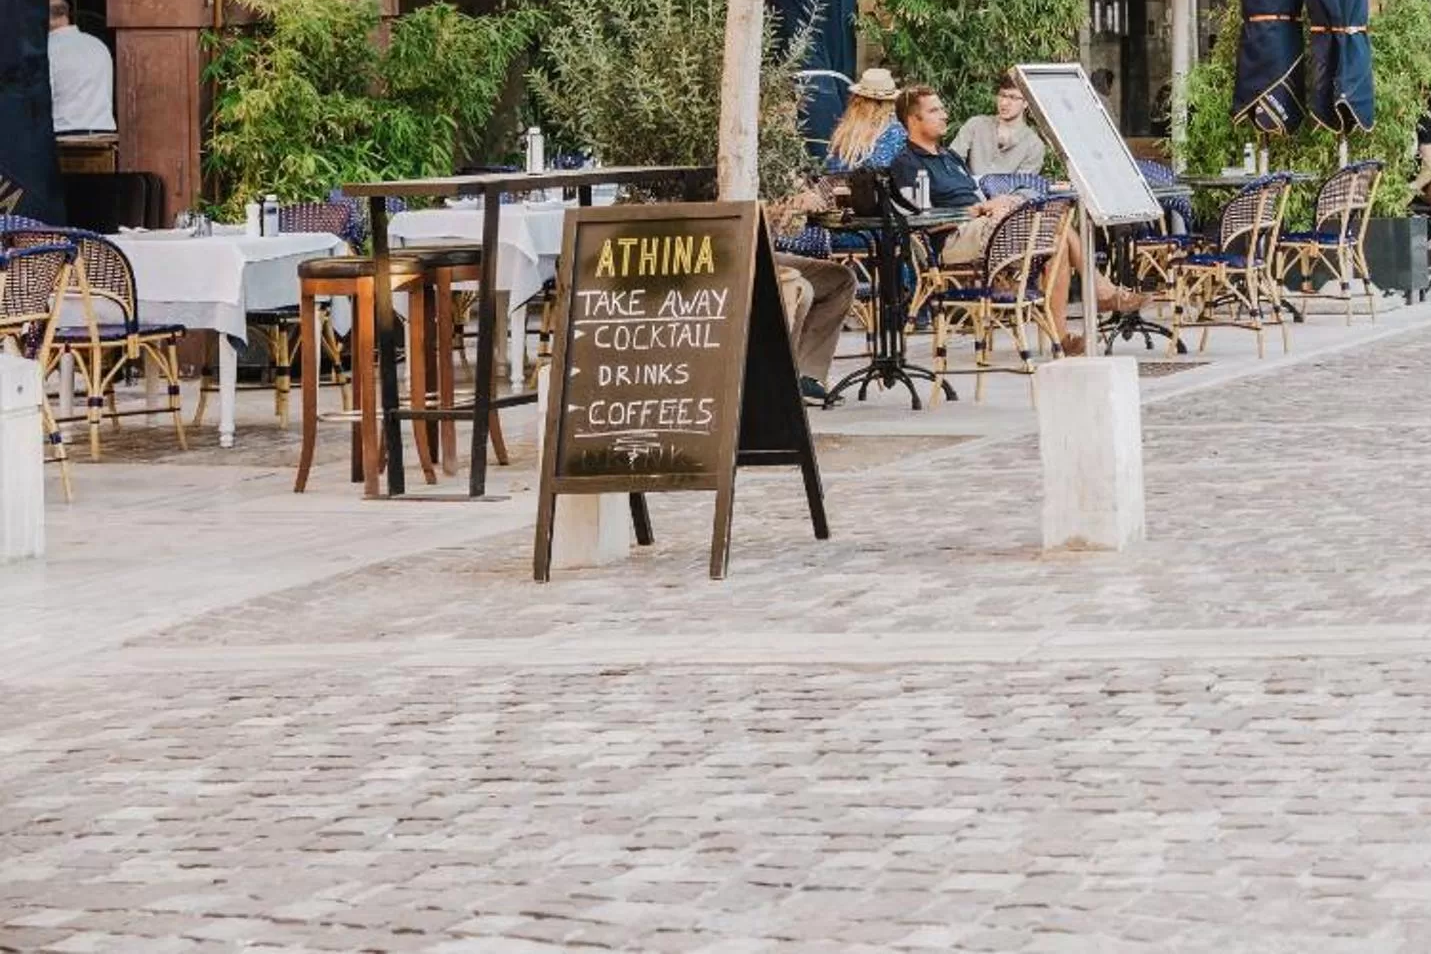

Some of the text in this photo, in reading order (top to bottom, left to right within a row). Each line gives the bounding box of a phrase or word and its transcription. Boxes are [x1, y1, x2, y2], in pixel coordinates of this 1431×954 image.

[595, 236, 715, 277] ATHINA
[577, 288, 729, 318] TAKE AWAY
[594, 323, 720, 350] COCKTAIL
[598, 364, 689, 387] DRINKS
[588, 397, 716, 426] COFFEES
